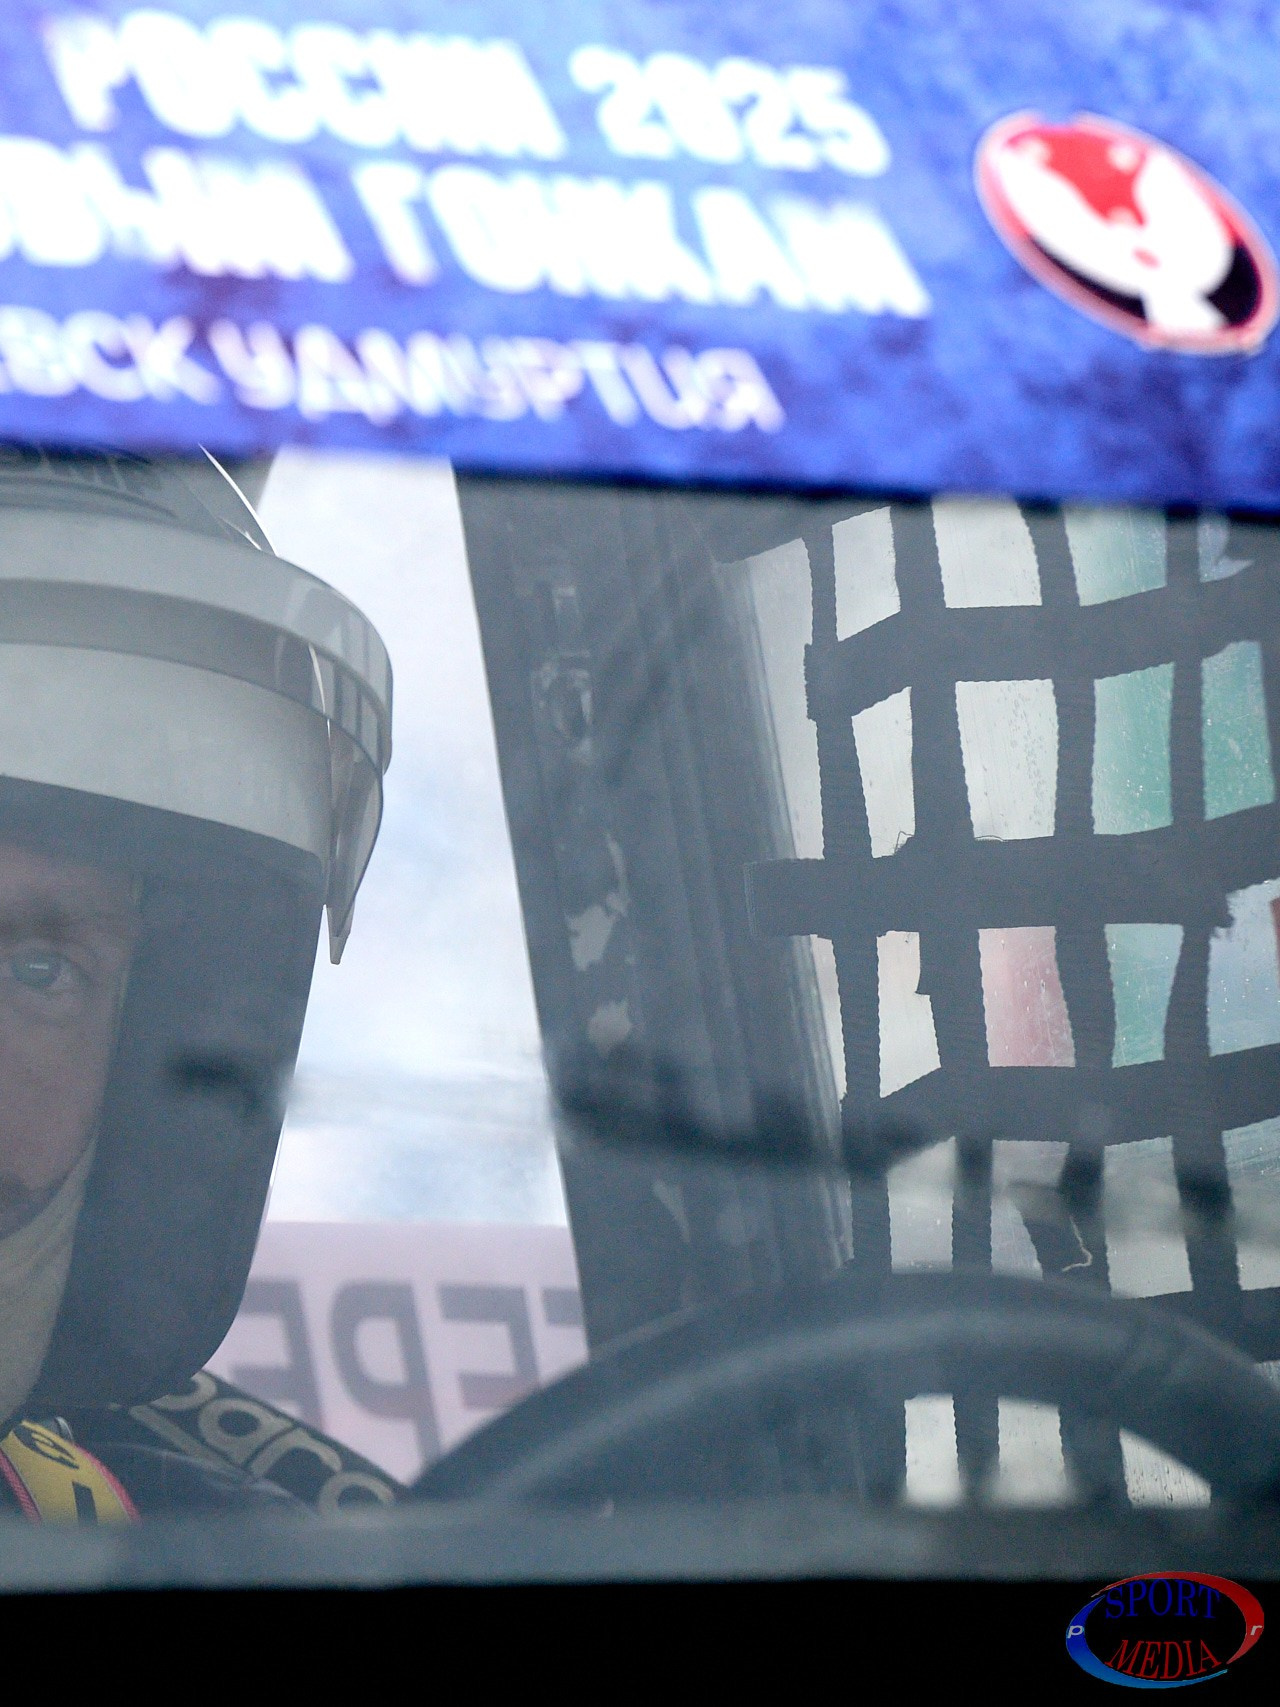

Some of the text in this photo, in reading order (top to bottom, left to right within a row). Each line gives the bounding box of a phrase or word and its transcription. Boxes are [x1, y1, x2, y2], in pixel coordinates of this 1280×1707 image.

[44, 9, 567, 159] РОССИИ
[568, 44, 891, 177] 2025
[352, 160, 932, 317] ГОНКАМ
[207, 318, 788, 434] УДМУРТИЯ
